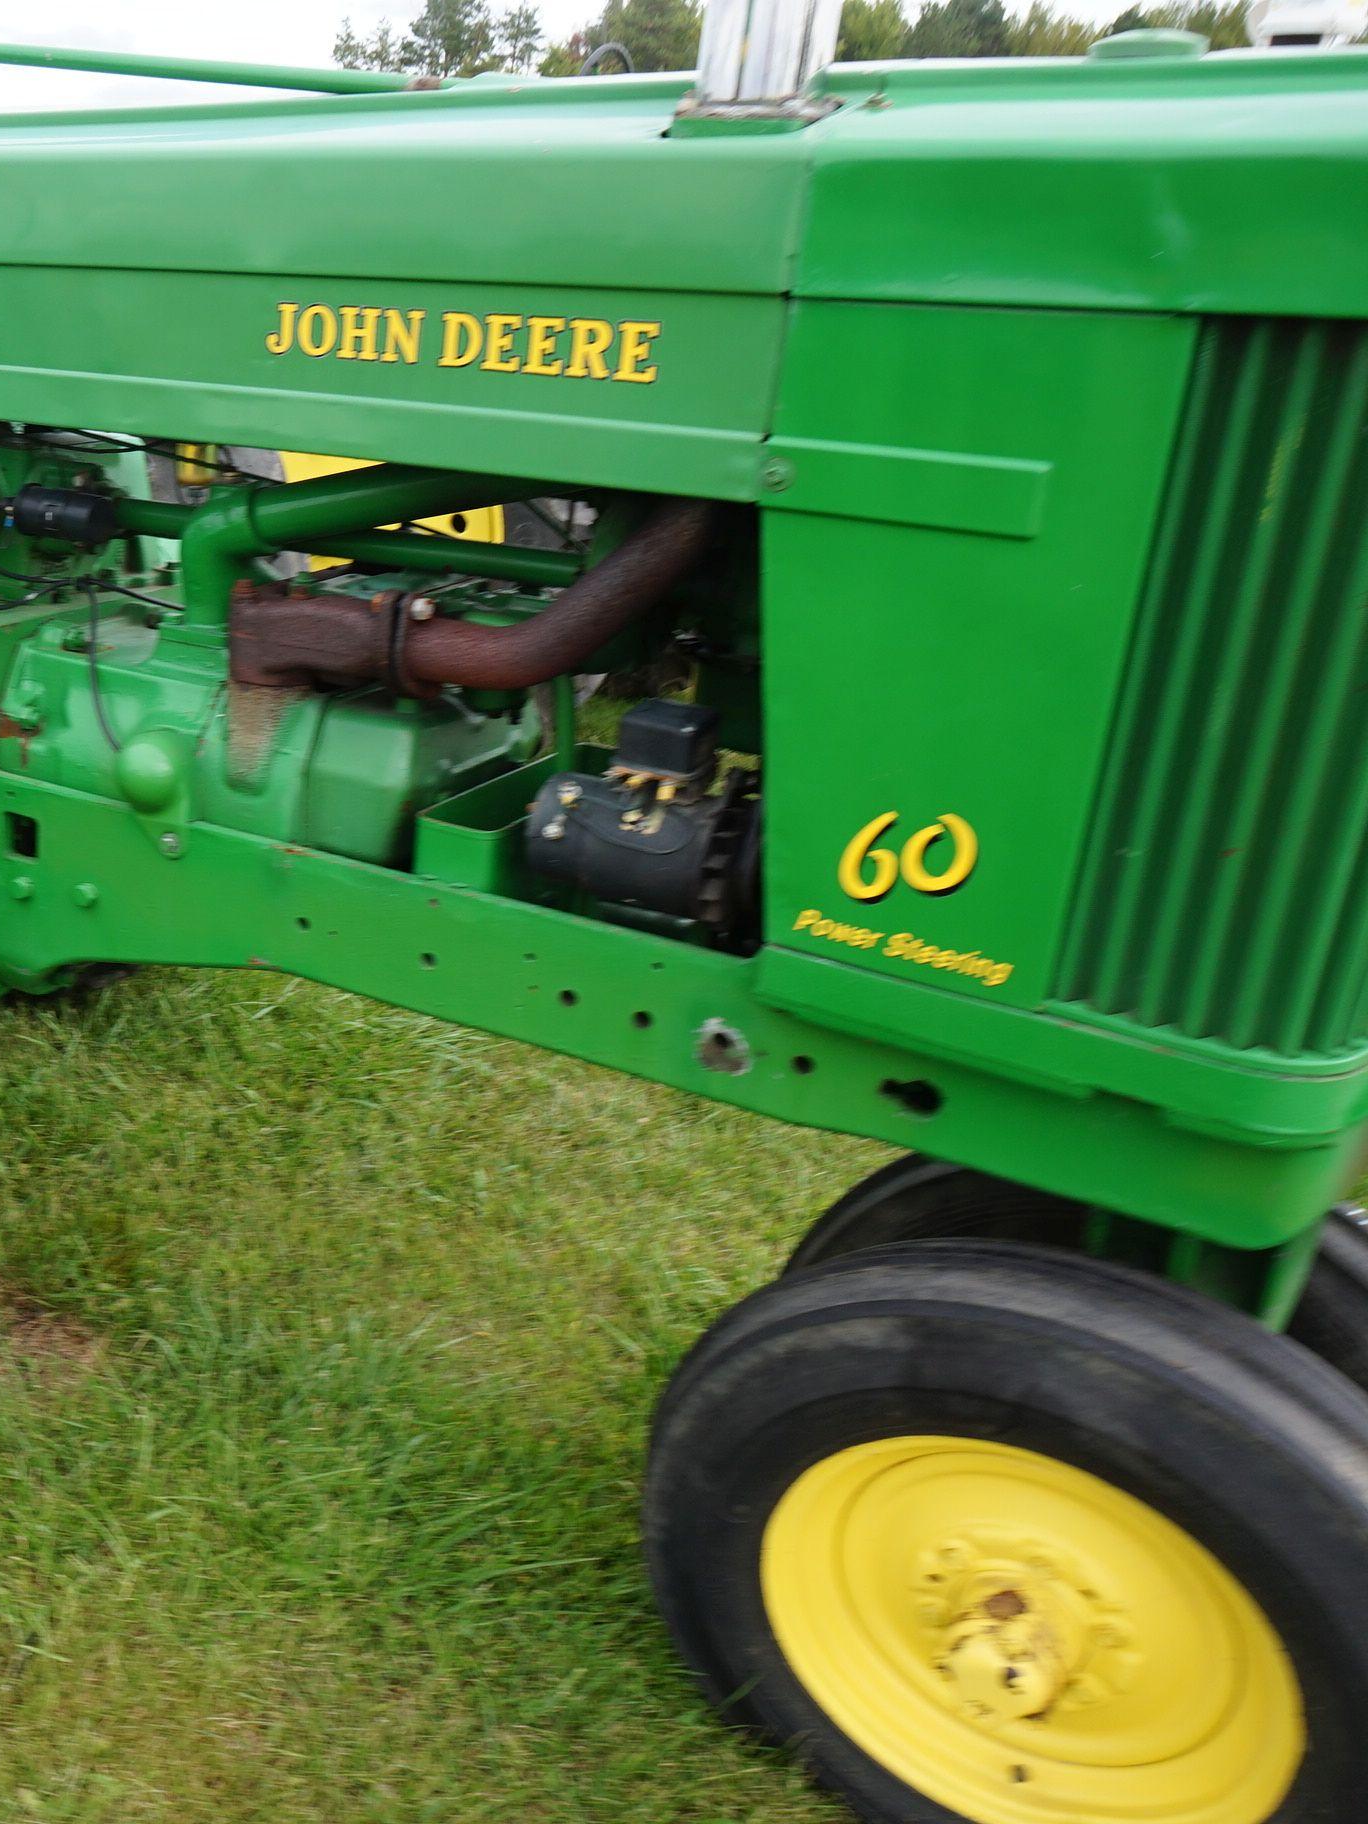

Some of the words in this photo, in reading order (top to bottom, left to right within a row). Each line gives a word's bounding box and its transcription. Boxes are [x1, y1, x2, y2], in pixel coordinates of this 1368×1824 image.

[265, 302, 426, 364] JOHN
[438, 311, 661, 384] DEERE
[837, 811, 978, 904] 60
[792, 909, 885, 950] Power
[883, 932, 1014, 987] Steering
